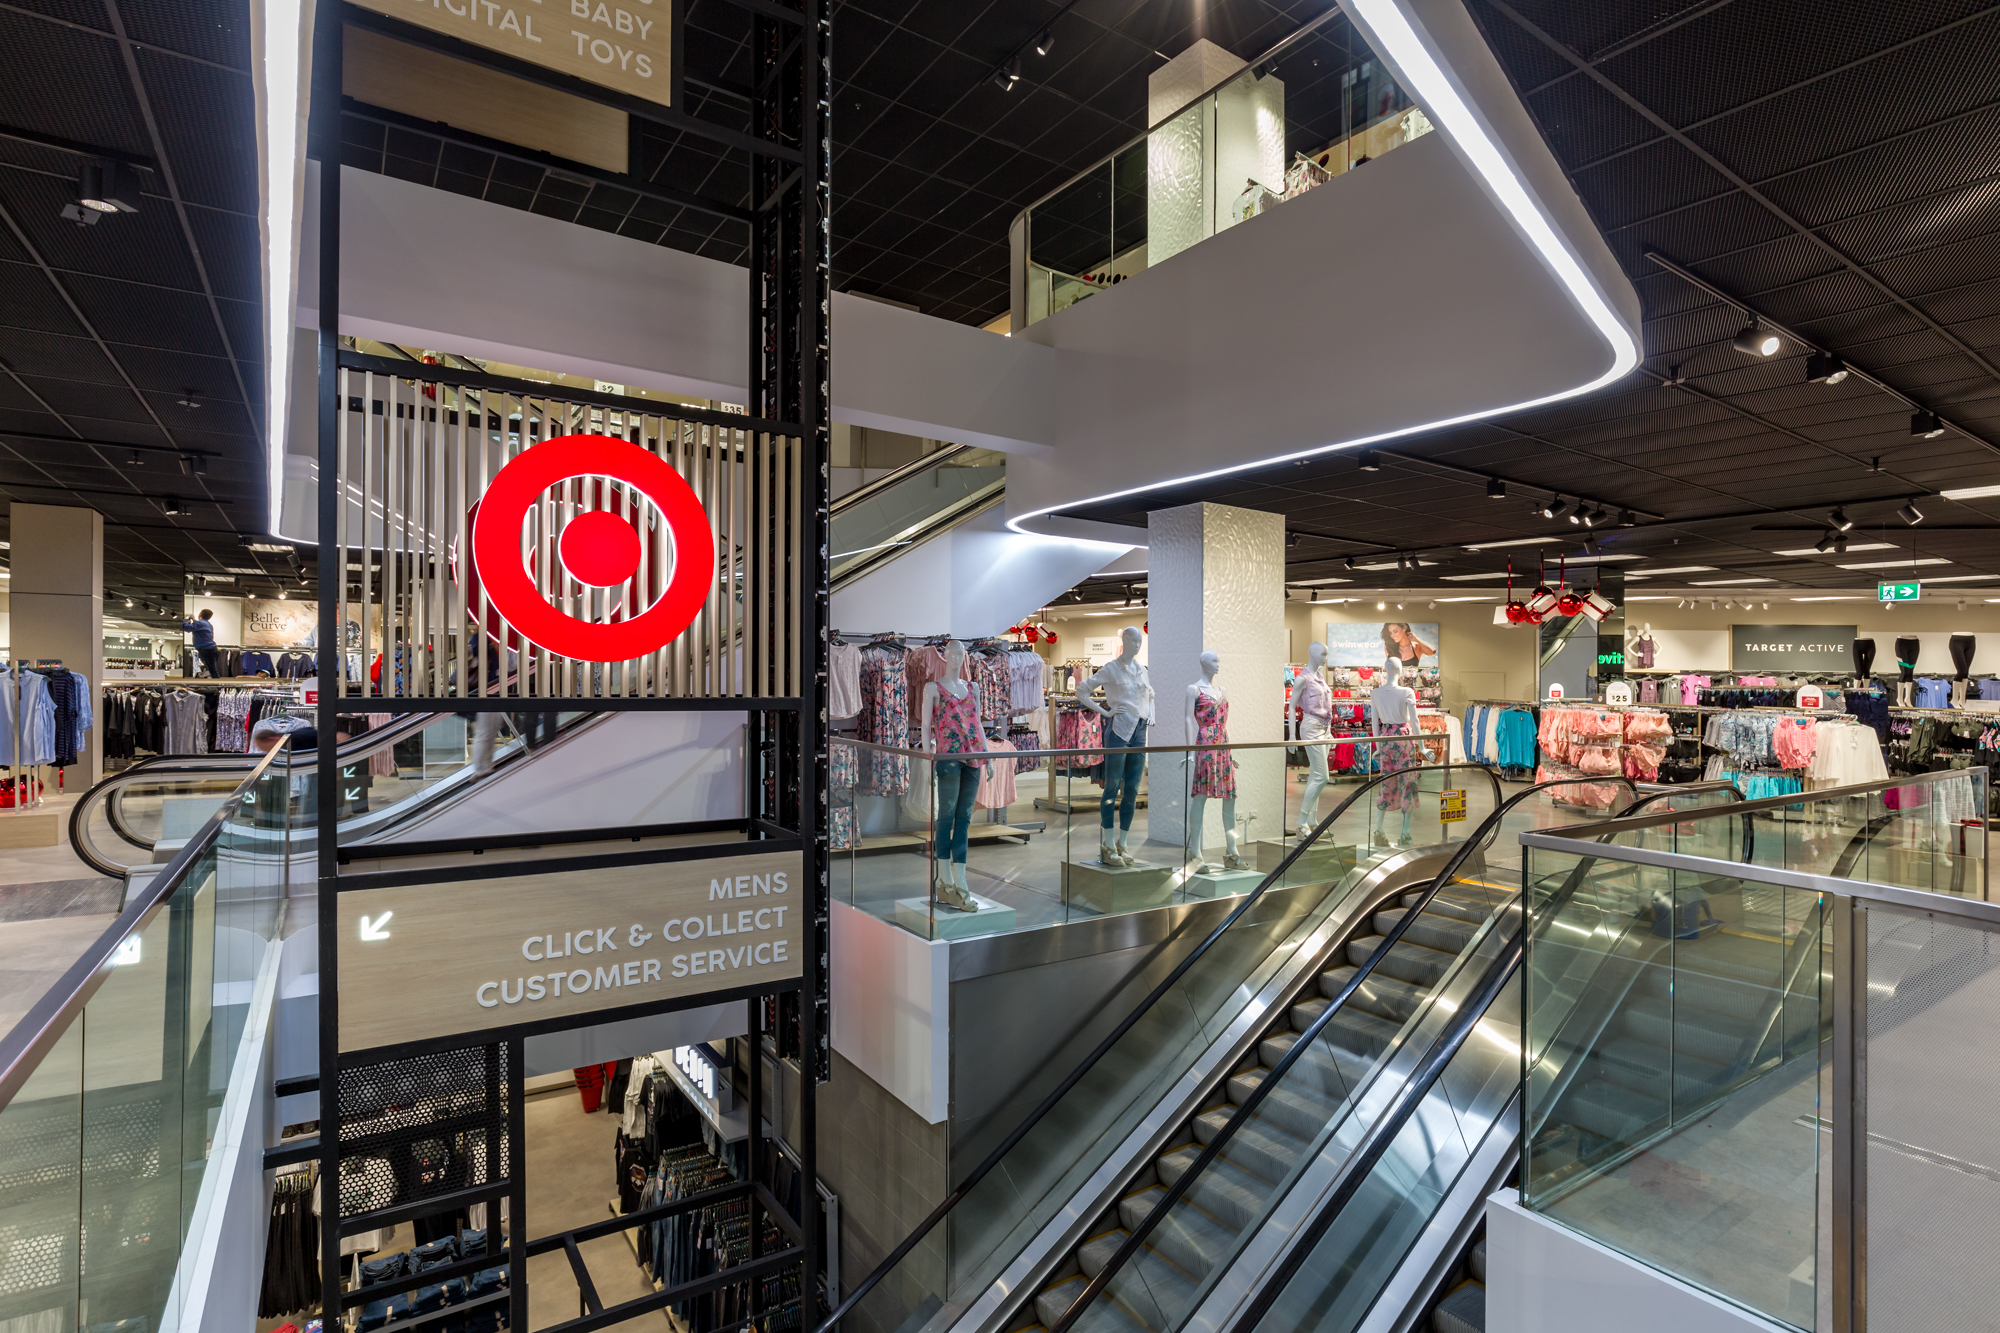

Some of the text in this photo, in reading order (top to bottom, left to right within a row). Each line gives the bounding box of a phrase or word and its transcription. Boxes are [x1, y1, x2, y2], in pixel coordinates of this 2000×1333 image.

[414, 0, 542, 43] GITAL
[571, 0, 653, 41] BABY
[571, 29, 653, 78] TOYS
[249, 612, 280, 623] Belle
[249, 622, 287, 633] Curve
[1745, 643, 1844, 653] TARGET ACTIVE
[709, 872, 788, 901] MENS
[522, 906, 788, 961] CLICK & COLLECT
[476, 940, 788, 1007] CUSTOMER SERVICE
